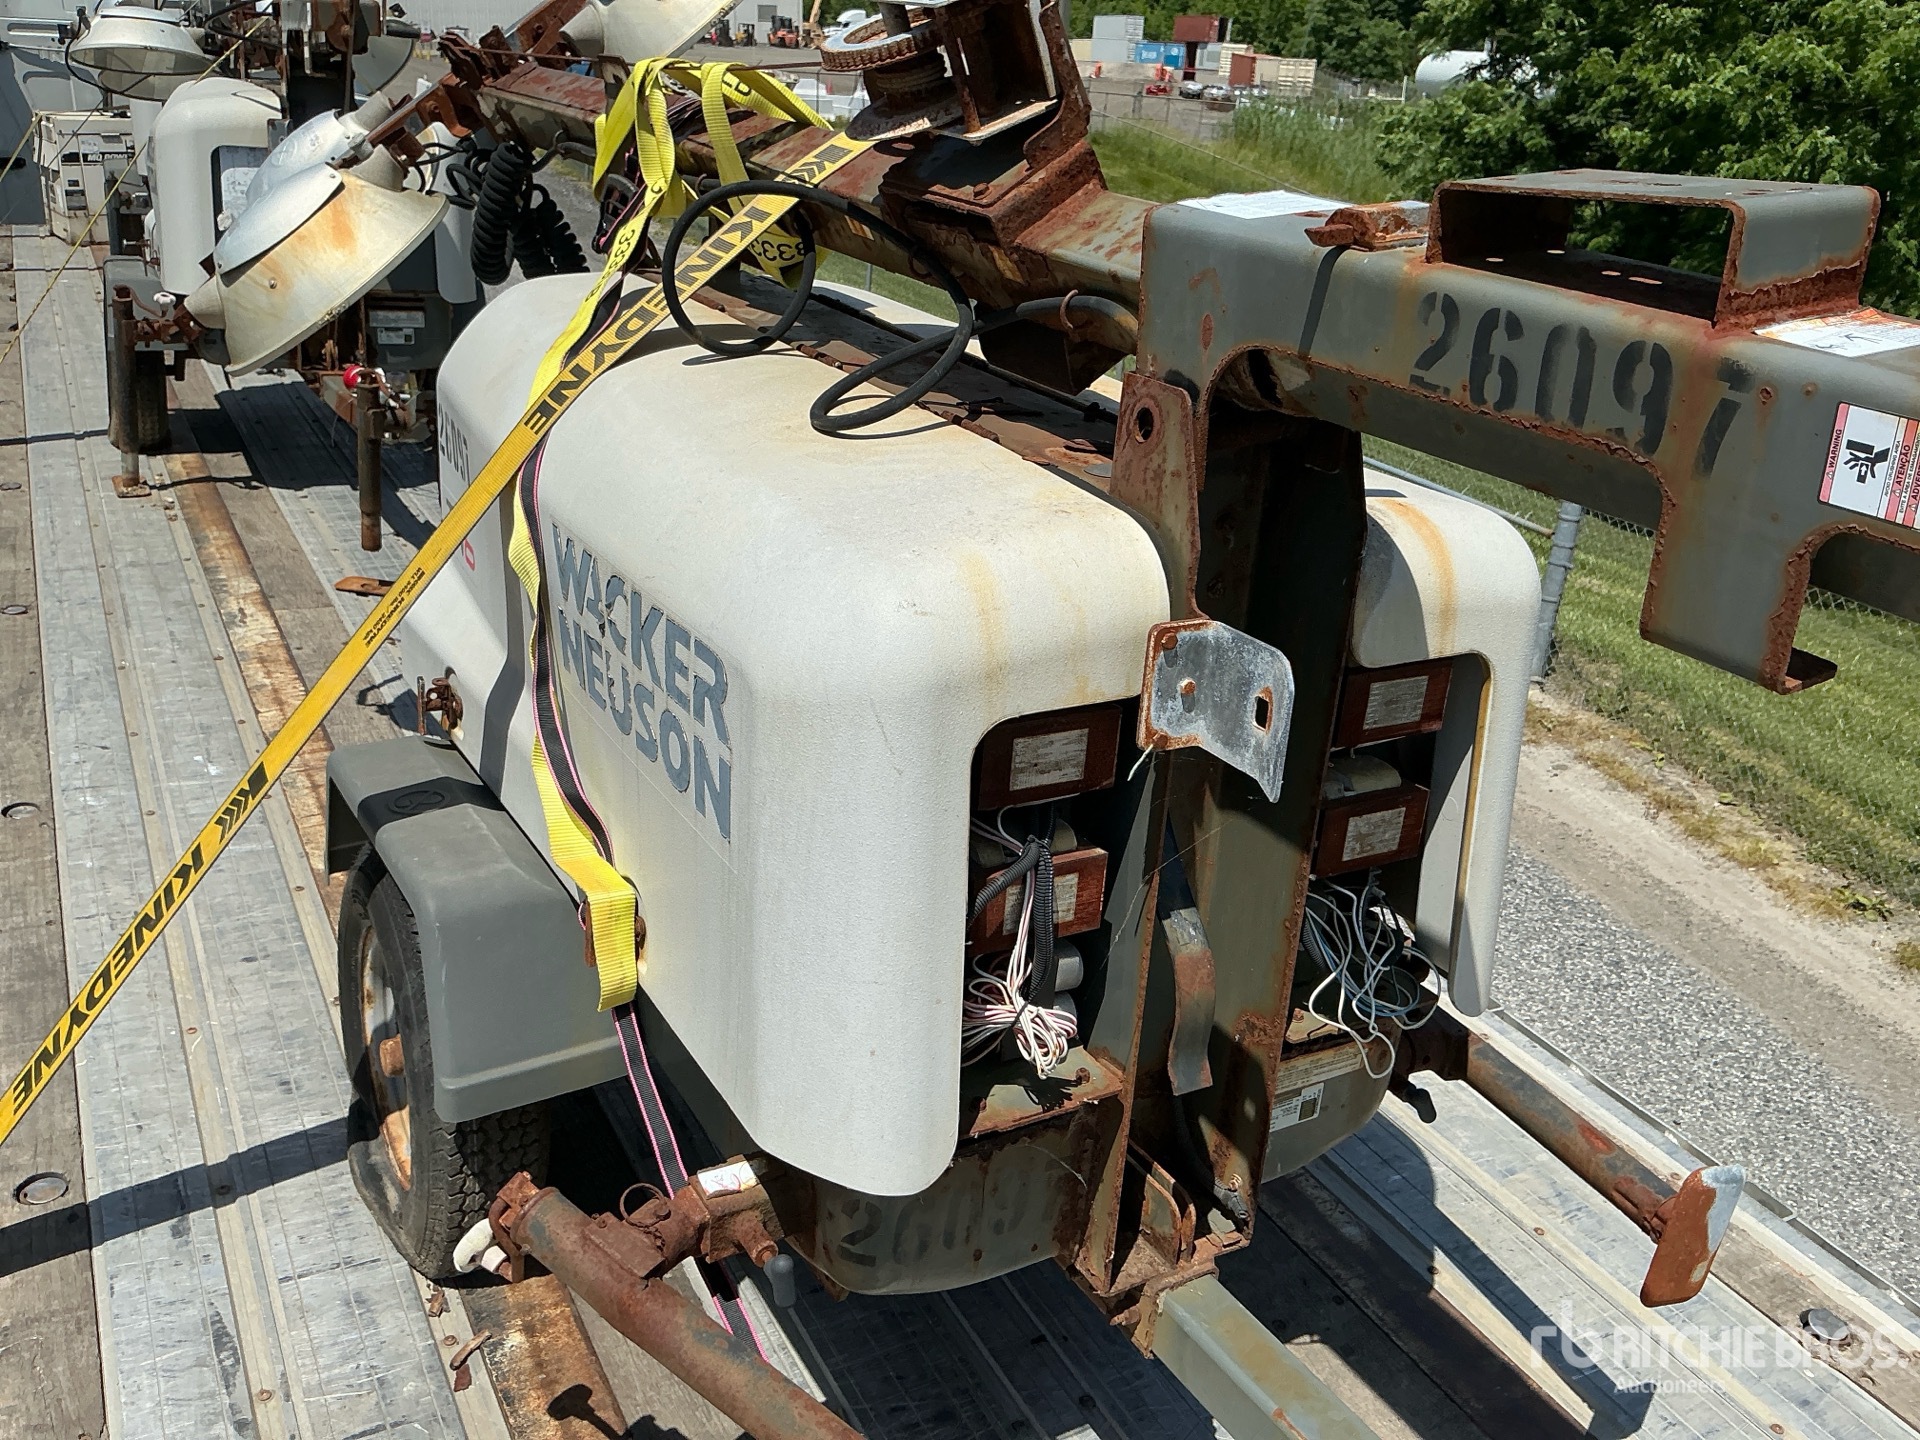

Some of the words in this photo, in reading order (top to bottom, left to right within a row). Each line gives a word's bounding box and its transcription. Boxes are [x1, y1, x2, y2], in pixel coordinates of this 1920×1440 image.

[524, 205, 772, 434] KINEDYNE
[1409, 291, 1752, 481] 26097
[1828, 429, 1842, 469] WARNING
[1895, 444, 1911, 486] ATENÇÃO
[552, 523, 731, 749] WACKER
[557, 605, 731, 843] NEUSON
[13, 841, 204, 1116] KINEDYNE
